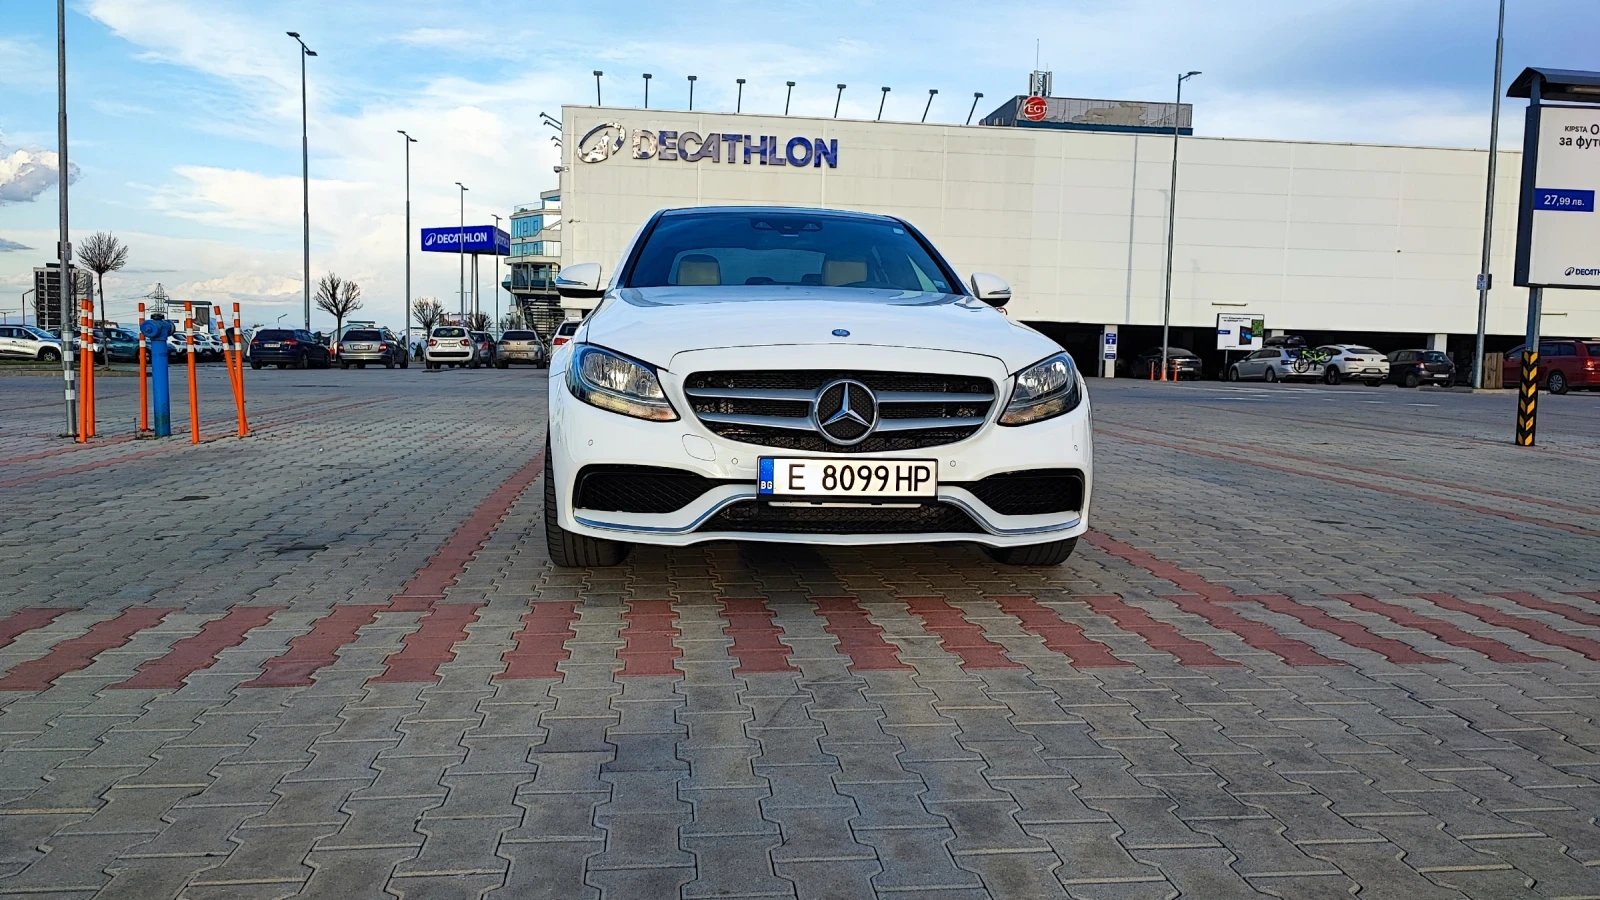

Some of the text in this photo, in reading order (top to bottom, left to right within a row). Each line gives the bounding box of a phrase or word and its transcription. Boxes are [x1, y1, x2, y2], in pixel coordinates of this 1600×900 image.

[1565, 126, 1588, 134] KIPSTA
[632, 128, 839, 169] DECATHLON
[1559, 135, 1600, 149] за фут
[1543, 194, 1570, 207] 27,99
[437, 231, 488, 244] DECATHLON
[788, 463, 806, 491] E
[821, 465, 890, 492] 8099
[760, 480, 773, 490] BG
